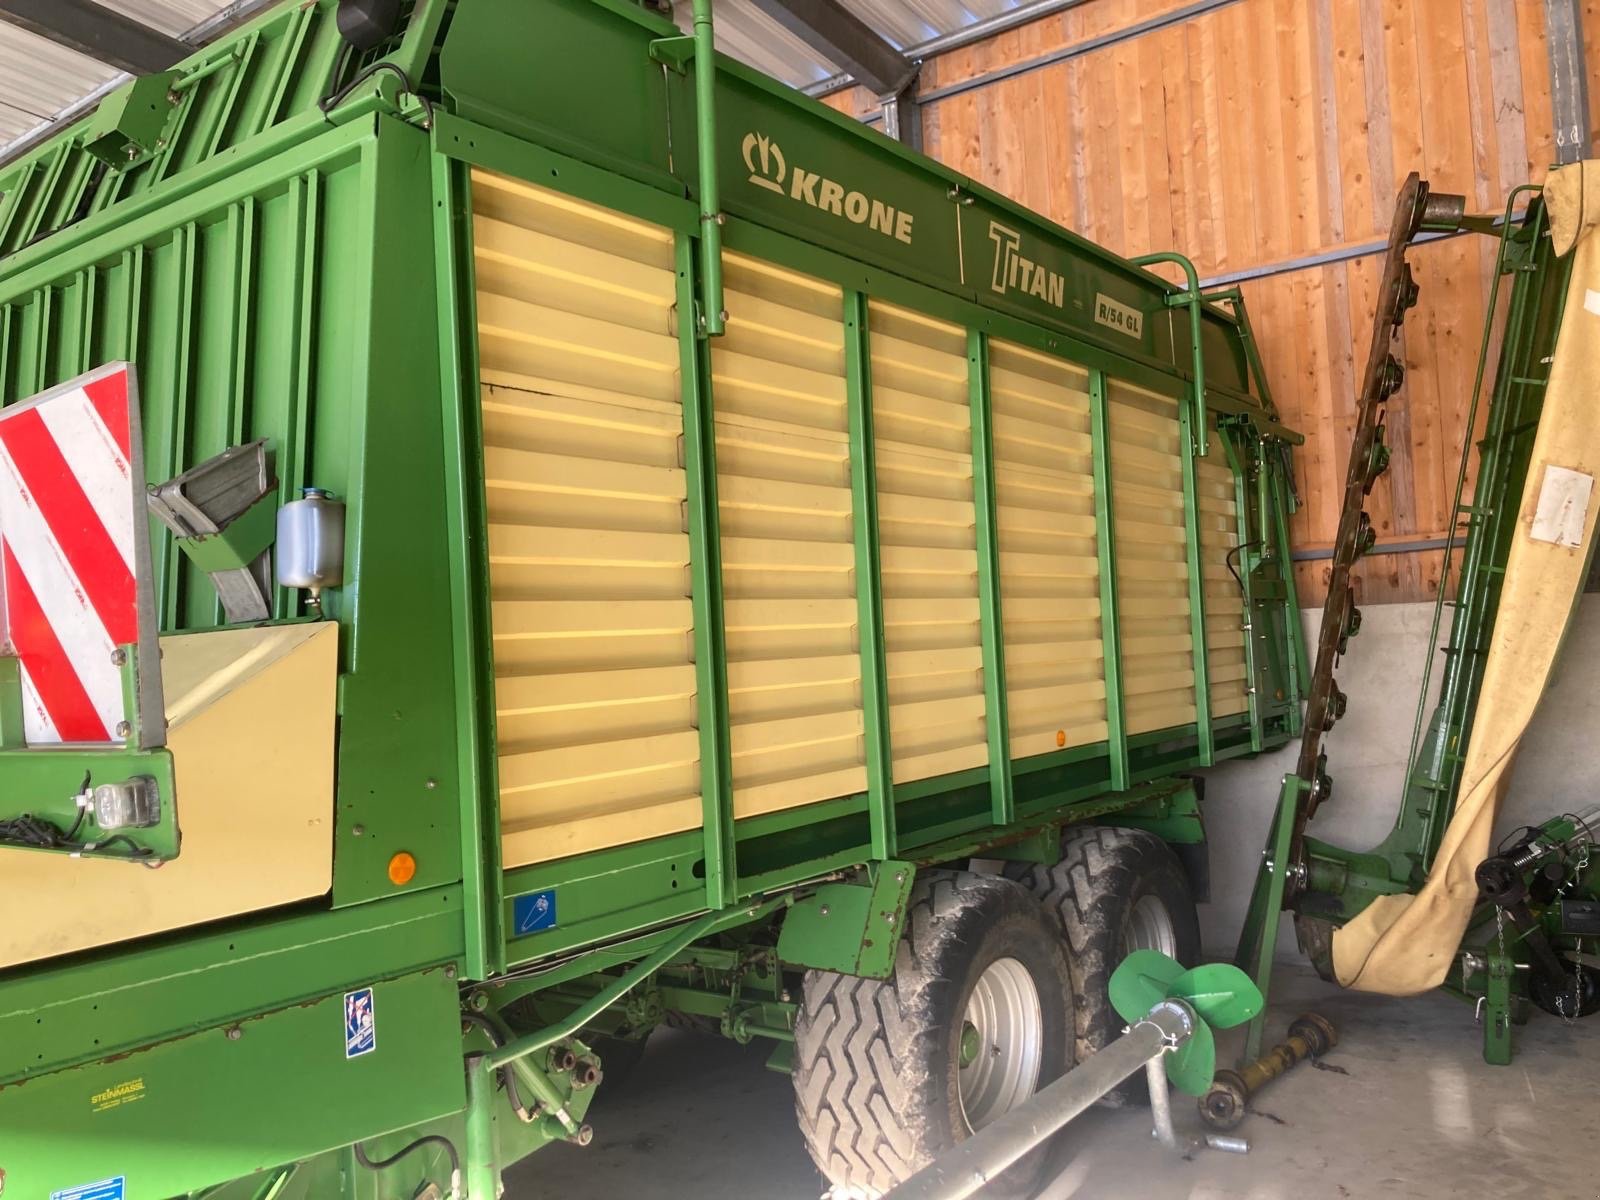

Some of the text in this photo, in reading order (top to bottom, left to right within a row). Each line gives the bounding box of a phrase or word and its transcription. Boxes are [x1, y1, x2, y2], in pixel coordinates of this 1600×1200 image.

[790, 167, 913, 244] KRONE
[988, 220, 1065, 308] TITAN
[1099, 302, 1139, 332] R/54 GL
